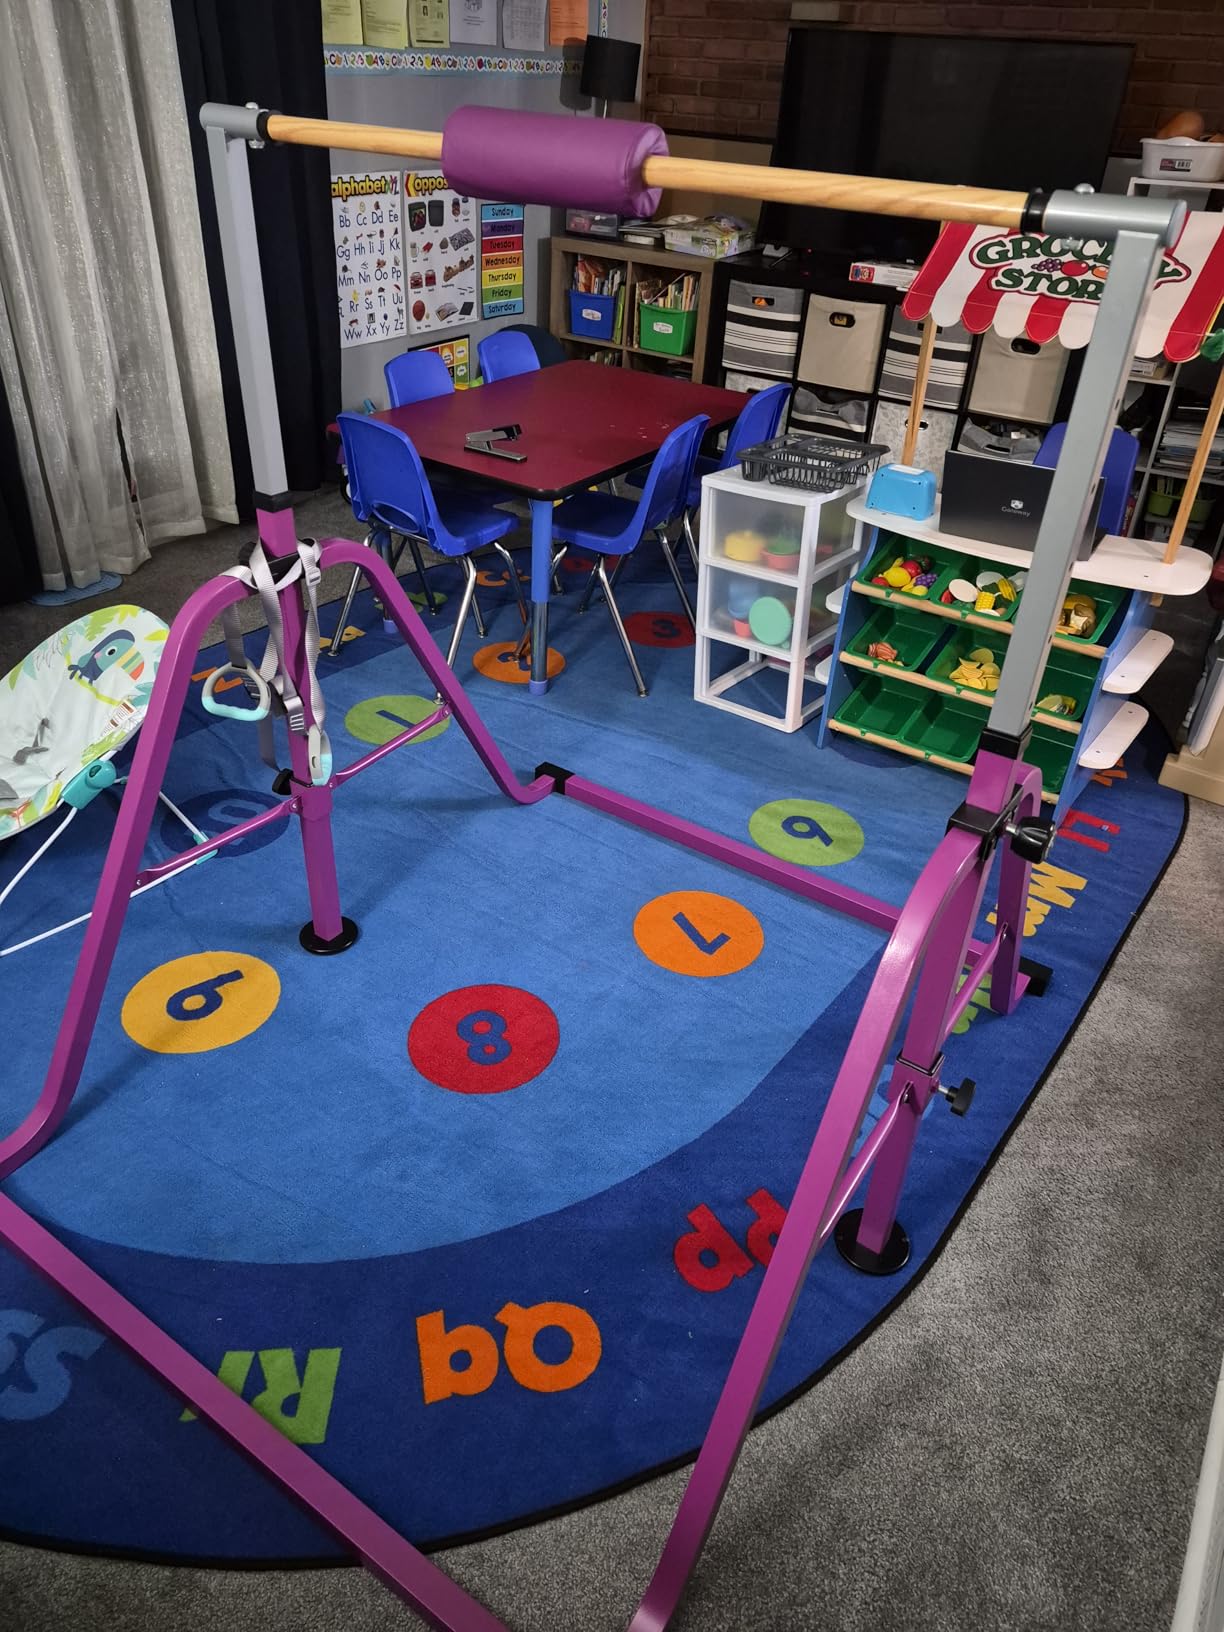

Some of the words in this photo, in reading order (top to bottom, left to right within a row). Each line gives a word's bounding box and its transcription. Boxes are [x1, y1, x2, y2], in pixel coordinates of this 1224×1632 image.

[331, 175, 386, 202] alphabet
[414, 175, 449, 196] oppos
[339, 215, 351, 228] Bb
[356, 212, 367, 226] Cc
[371, 211, 383, 224] Dd
[388, 209, 399, 222] Ee
[492, 206, 514, 217] Sunday
[490, 223, 515, 234] Monday
[336, 245, 351, 261] Gg
[353, 242, 366, 256] Hh
[377, 240, 385, 256] Jj
[389, 238, 401, 252] Kk
[490, 240, 516, 250] Tuesday
[485, 255, 520, 267] Wednesday
[976, 236, 1183, 279] GROCY
[338, 274, 355, 288] Mm
[358, 271, 371, 285] Nn
[374, 268, 389, 281] Oo
[391, 266, 402, 281] Pp
[488, 272, 517, 283] Thursday
[995, 268, 1105, 300] STOR
[349, 300, 360, 313] Rr
[364, 297, 374, 310] Ss
[391, 292, 403, 305] Uu
[491, 288, 513, 299] Friday
[488, 303, 517, 314] Saturday
[343, 327, 363, 341] Ww
[365, 324, 378, 338] Xx
[379, 321, 391, 336] Yy
[393, 318, 405, 331] Zz
[672, 911, 731, 955] 7
[456, 1009, 512, 1066] 8
